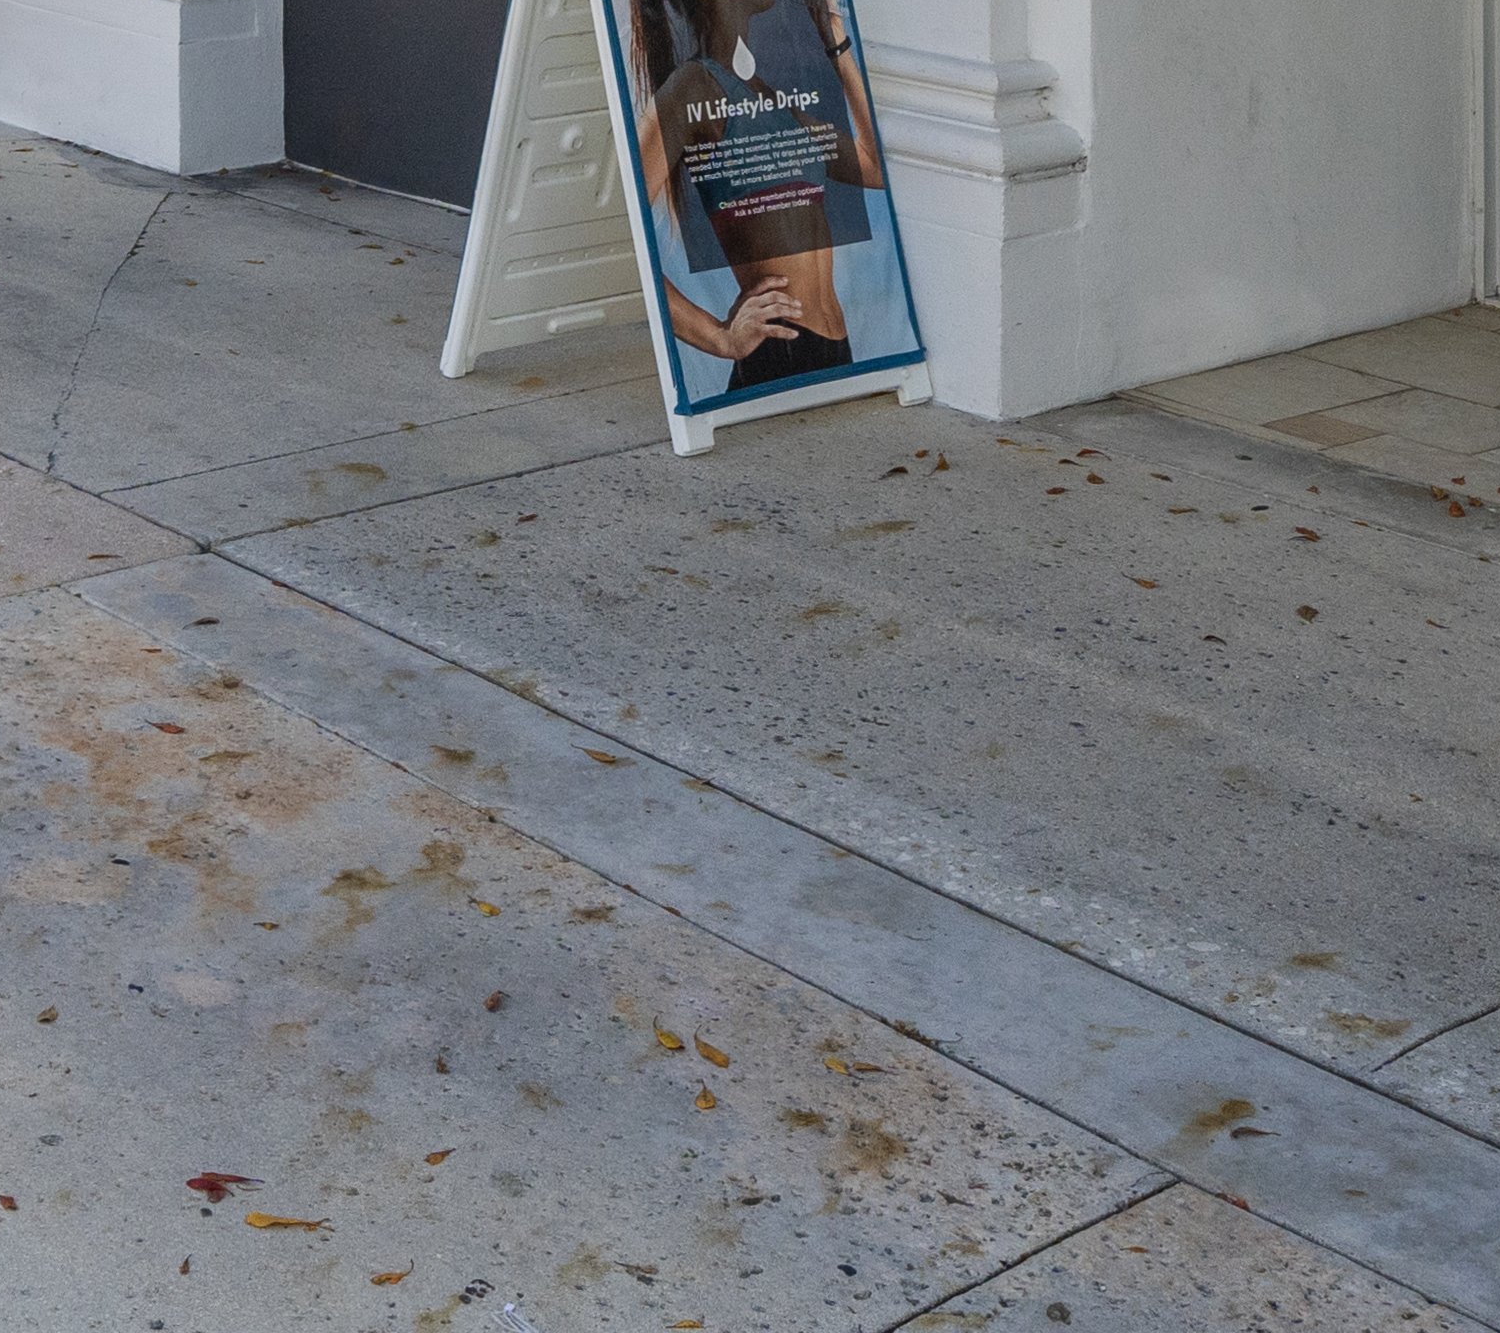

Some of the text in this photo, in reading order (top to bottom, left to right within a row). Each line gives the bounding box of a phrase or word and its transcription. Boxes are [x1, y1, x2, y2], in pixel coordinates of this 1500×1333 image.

[686, 87, 819, 123] IV Lifestyle Drips
[683, 144, 698, 152] Your
[698, 142, 715, 150] body
[733, 135, 750, 144] hard
[810, 124, 827, 132] have
[684, 154, 699, 162] work
[715, 150, 723, 158] to
[733, 147, 744, 155] the
[745, 142, 771, 153] essential
[771, 139, 797, 148] vitamins
[797, 136, 810, 145] and
[811, 132, 838, 142] nutrients
[816, 152, 832, 162] cells
[734, 207, 747, 217] Ask
